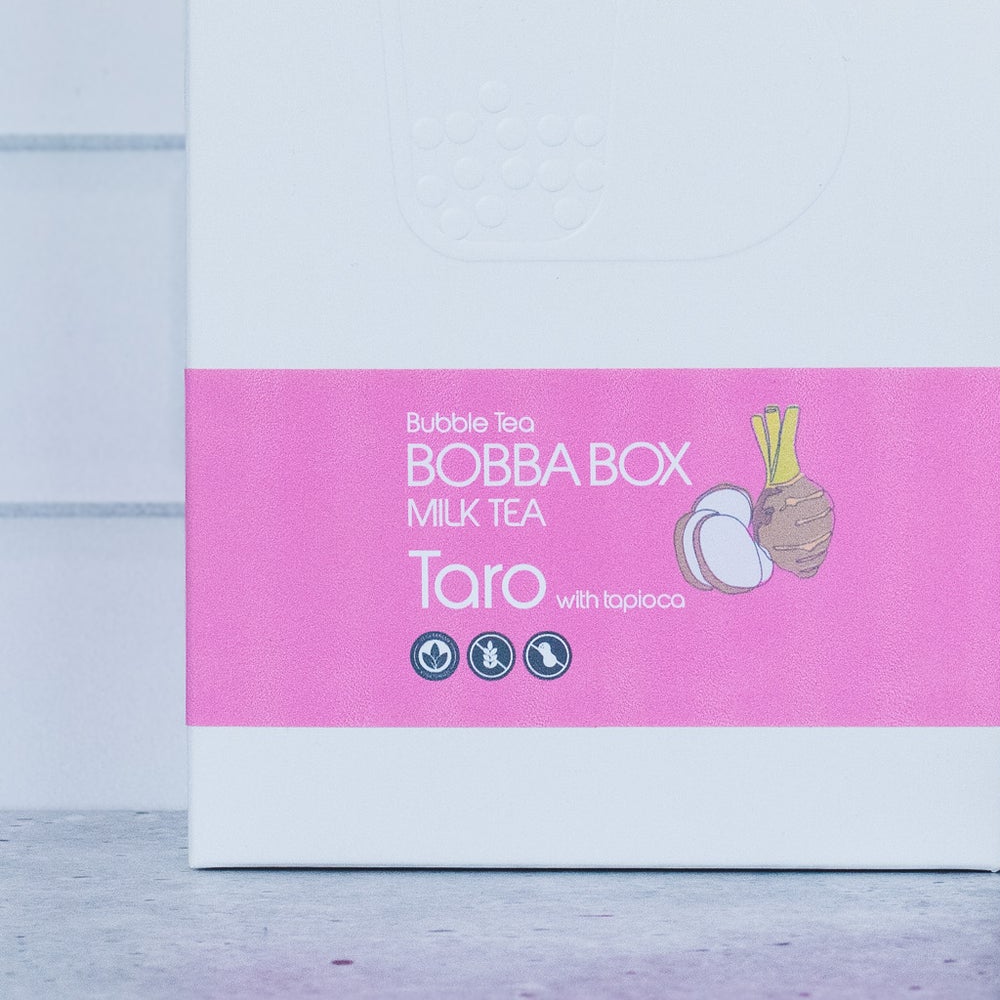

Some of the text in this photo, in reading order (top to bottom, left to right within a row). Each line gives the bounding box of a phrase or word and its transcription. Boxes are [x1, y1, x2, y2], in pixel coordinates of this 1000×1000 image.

[406, 411, 535, 433] Bubble Tea
[406, 441, 693, 487] BOBBA BOX
[407, 498, 547, 527] MILK TEA
[407, 549, 686, 613] Taro with tapioca
